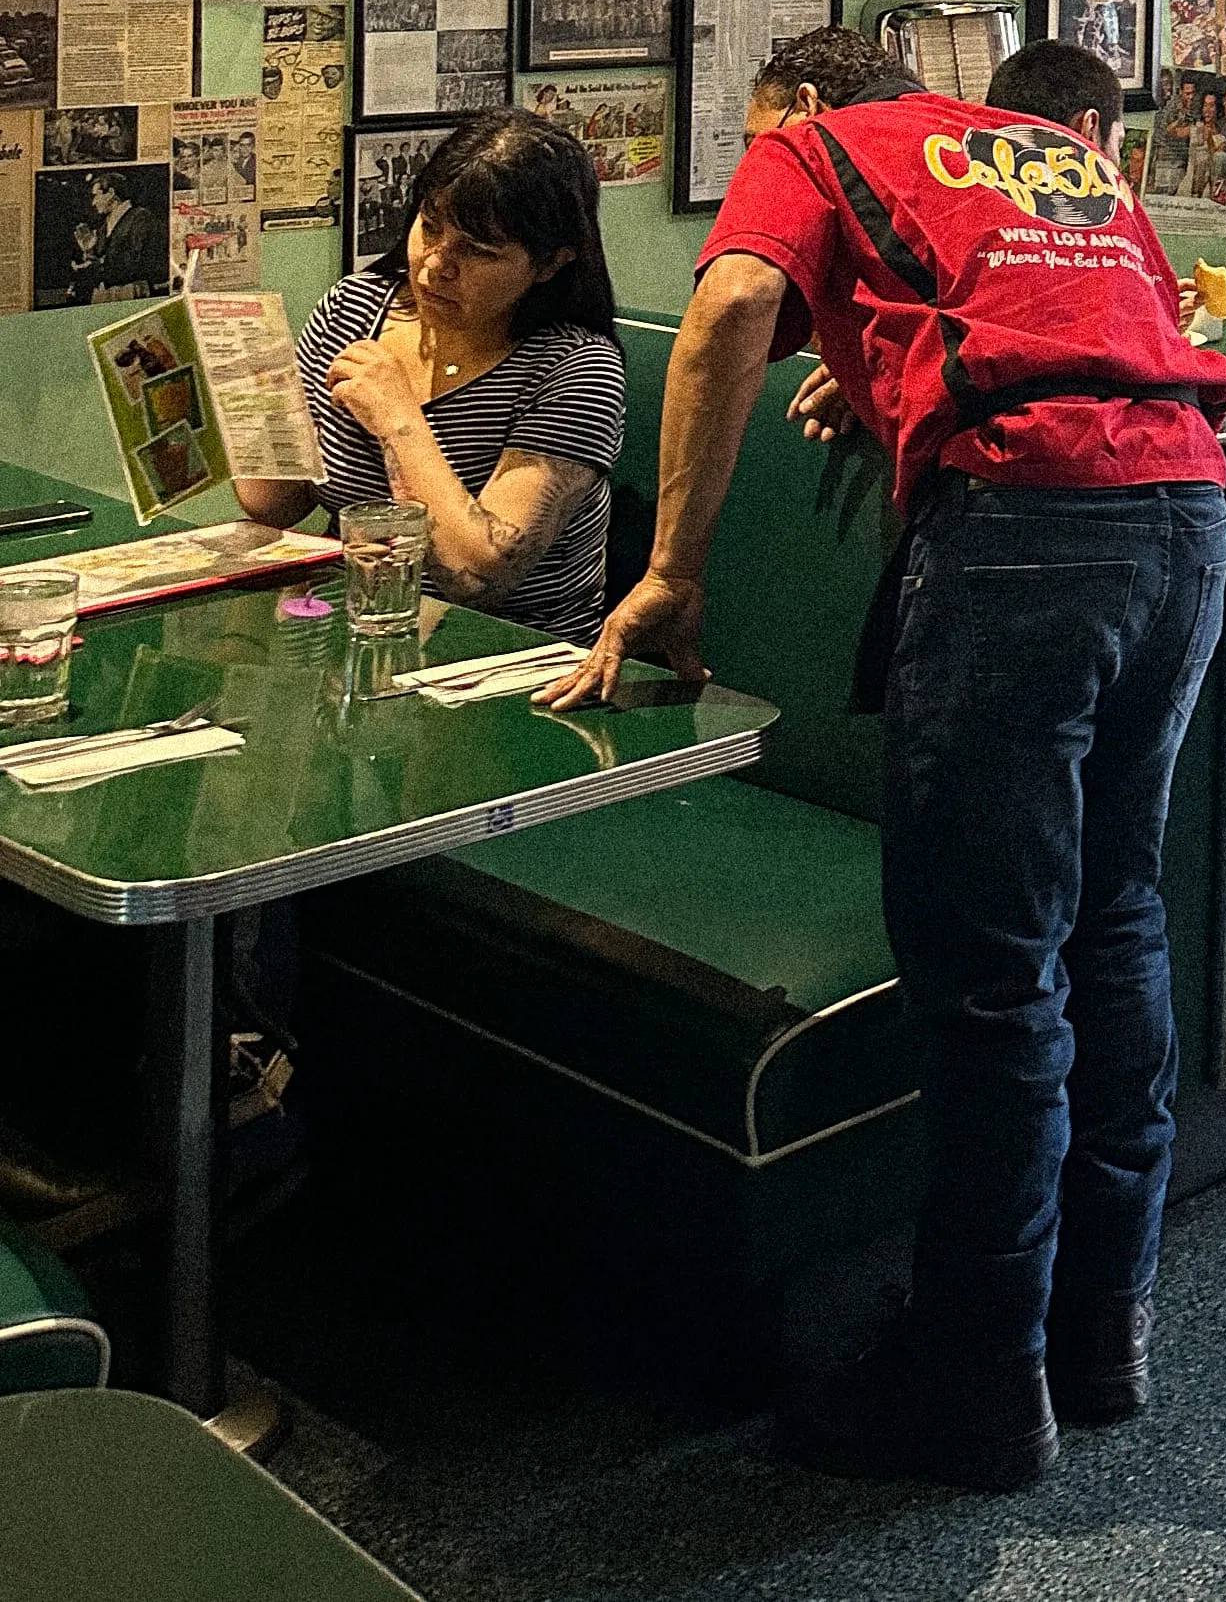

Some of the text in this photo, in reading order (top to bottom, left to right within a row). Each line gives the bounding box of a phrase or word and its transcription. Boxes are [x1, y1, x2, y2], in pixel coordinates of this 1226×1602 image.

[174, 100, 217, 112] WHOEVER
[218, 99, 239, 110] YOU
[923, 132, 1053, 218] Cafe
[998, 226, 1086, 247] WEST LOS
[1042, 247, 1073, 270] You
[1075, 251, 1100, 269] Eat
[1101, 255, 1118, 268] to
